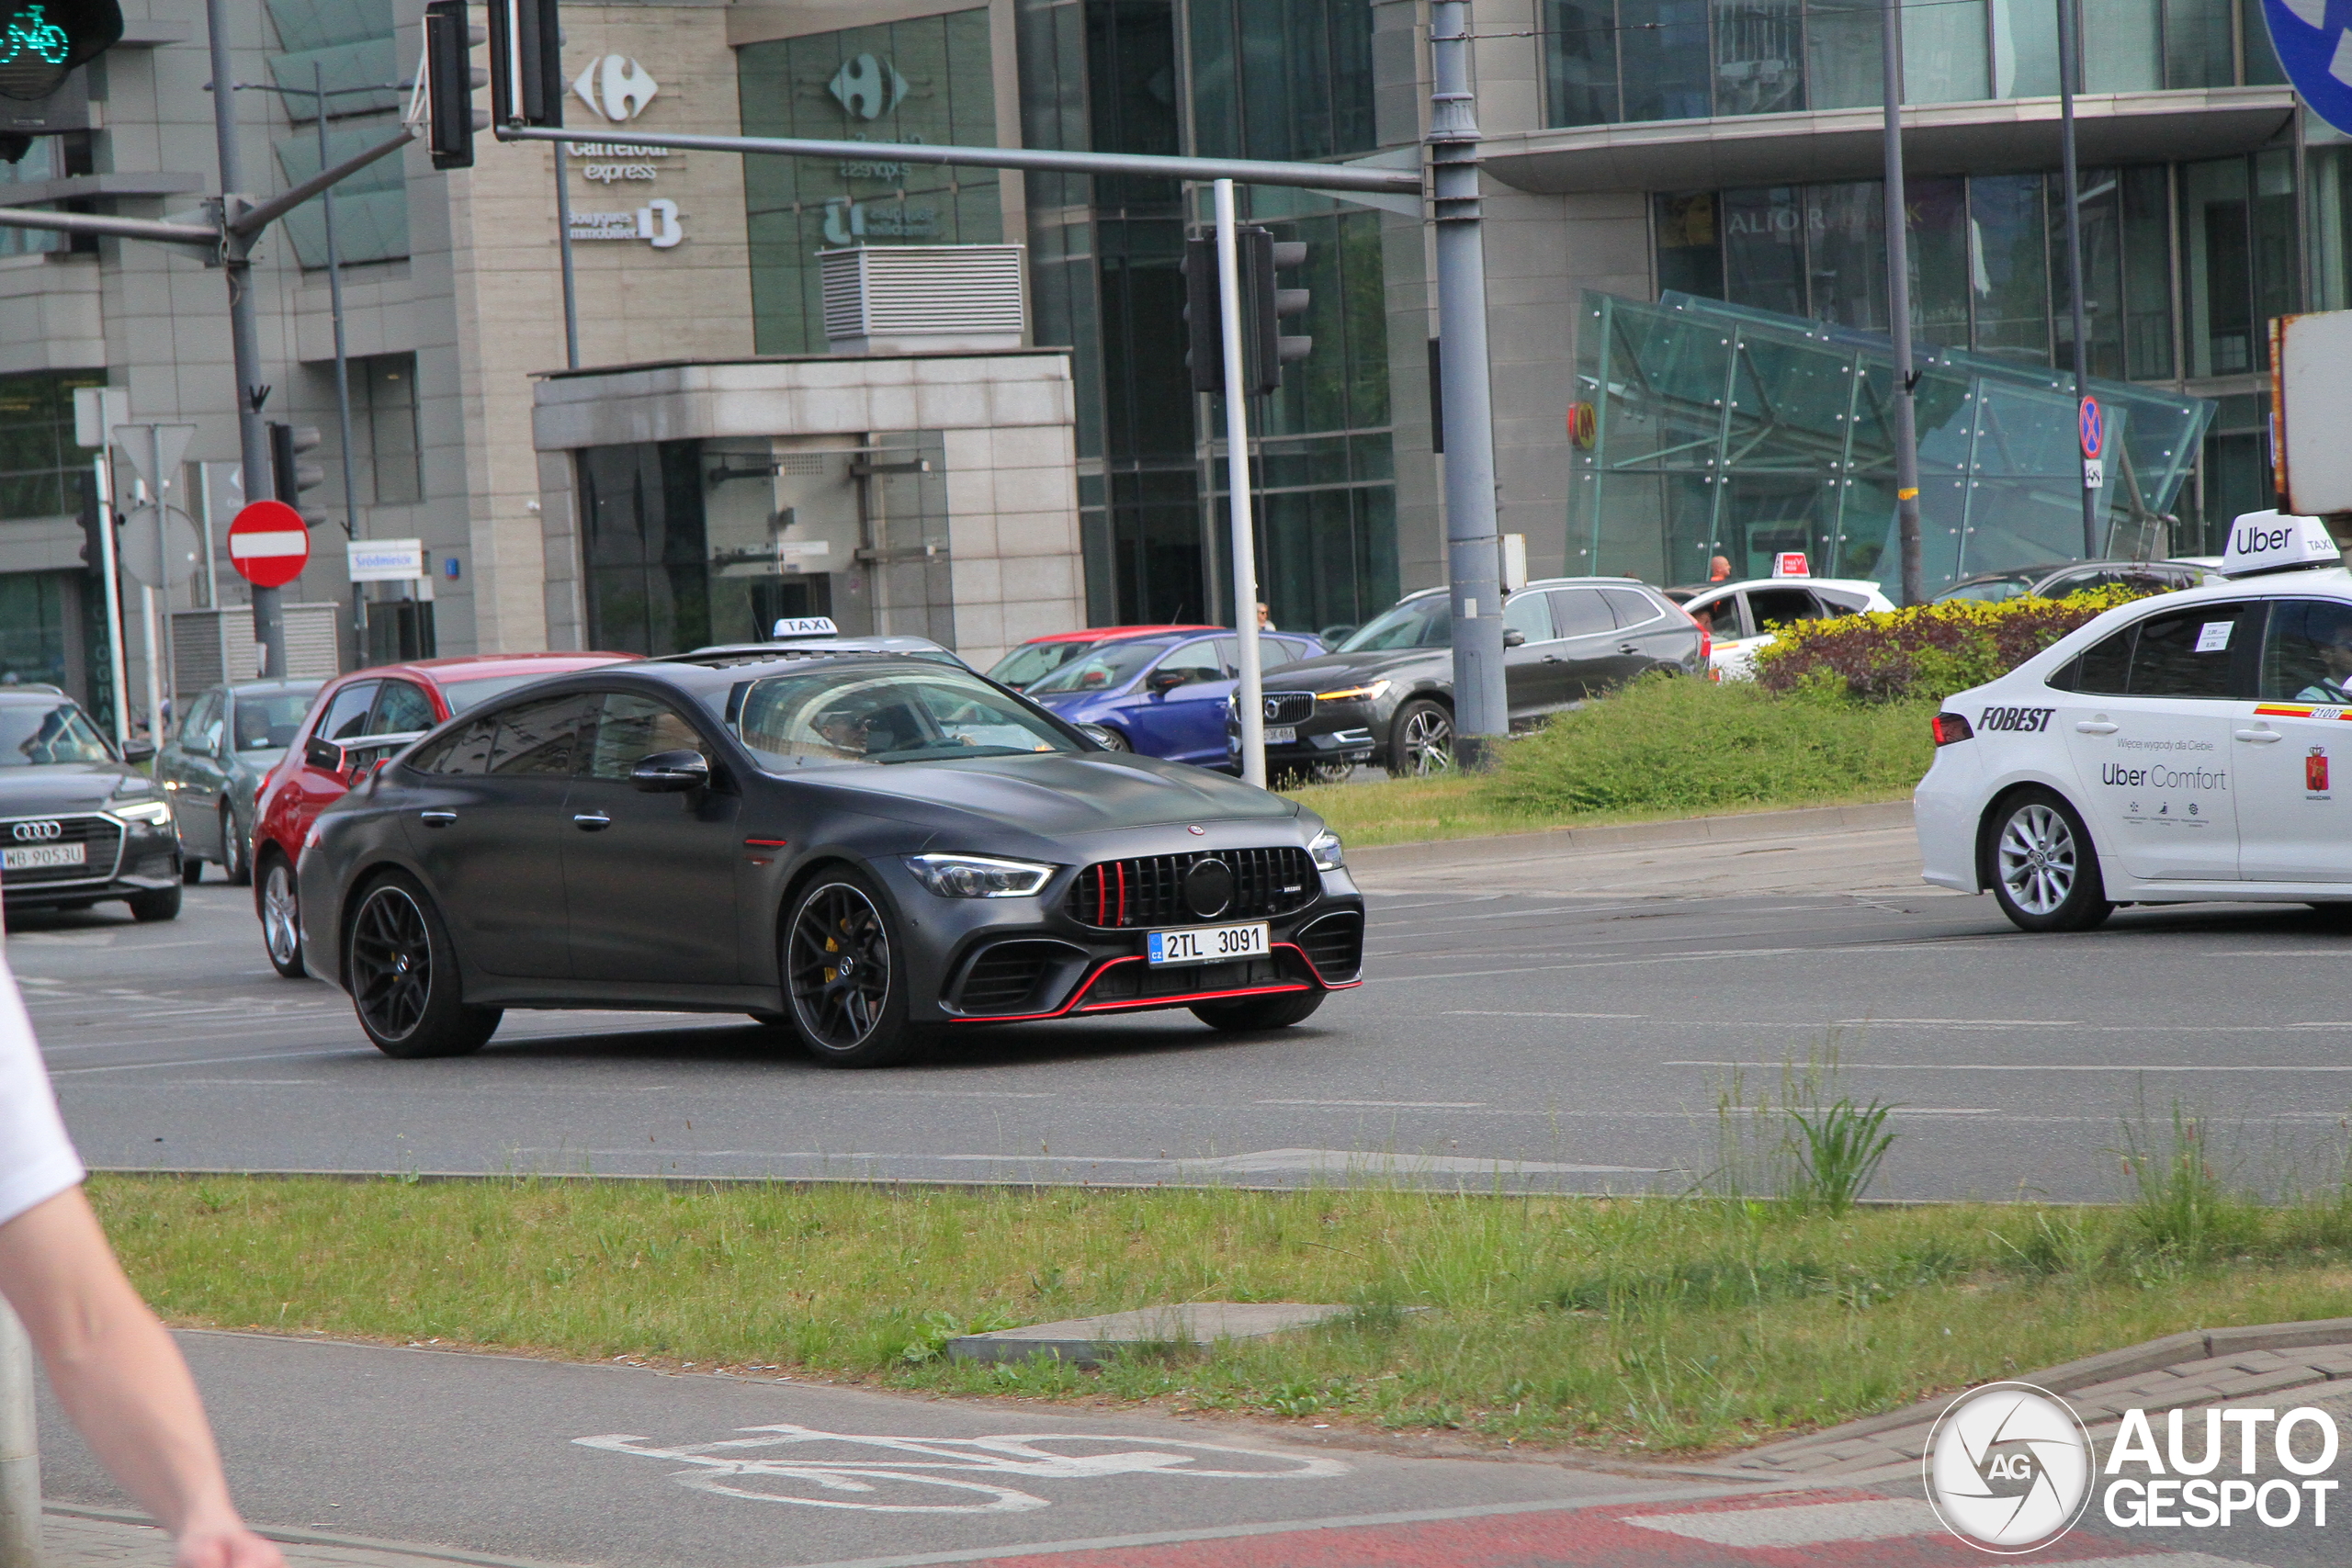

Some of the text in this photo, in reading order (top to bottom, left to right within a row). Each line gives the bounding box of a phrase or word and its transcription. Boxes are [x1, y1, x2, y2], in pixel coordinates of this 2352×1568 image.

[583, 163, 658, 184] express
[2236, 526, 2293, 555] Uber
[2306, 539, 2334, 551] TAXI
[785, 619, 830, 632] TAXI
[1977, 706, 2056, 732] FOBEST
[2312, 708, 2343, 717] 21007
[2102, 762, 2226, 790] Uber Comfort
[6, 847, 82, 867] WB 9053U
[1167, 927, 1261, 958] 2TL 3091
